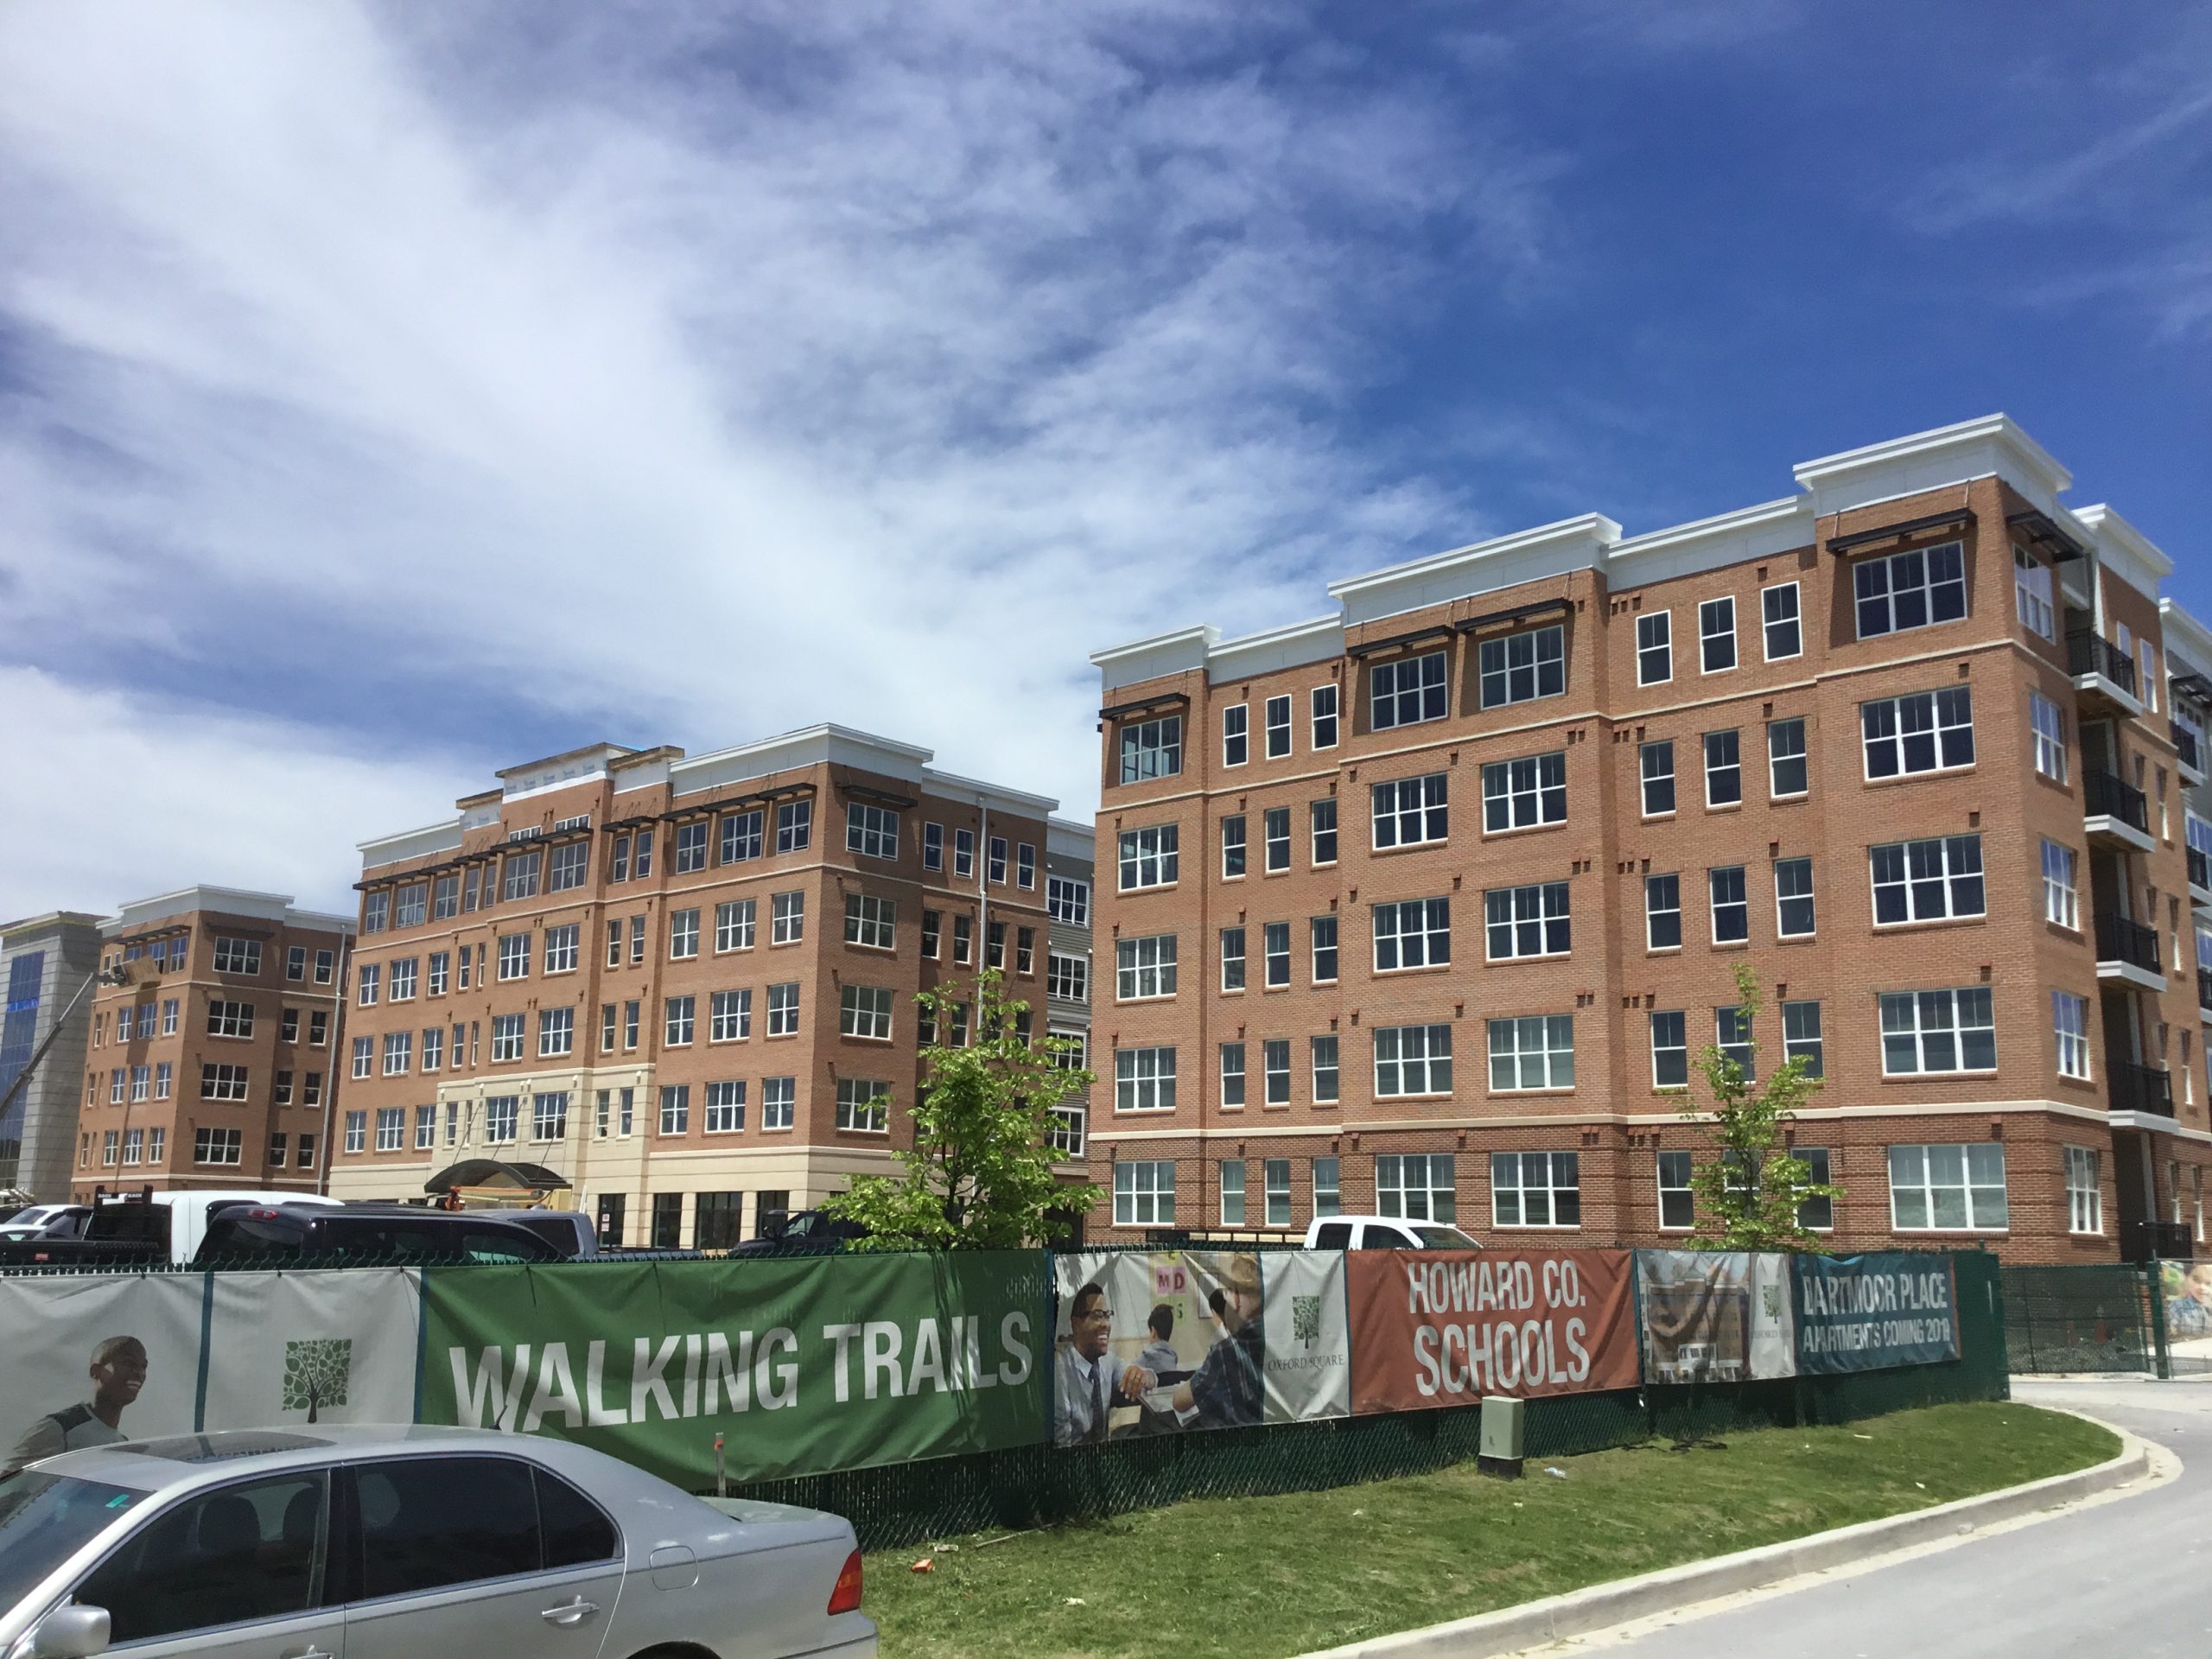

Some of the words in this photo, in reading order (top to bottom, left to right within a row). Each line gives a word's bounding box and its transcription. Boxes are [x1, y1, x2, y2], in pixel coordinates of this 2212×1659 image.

[1174, 1272, 1185, 1290] D
[1408, 1261, 1534, 1314] HOWARD
[1542, 1259, 1586, 1309] CO.
[1802, 1274, 1897, 1315] DARTMOOR
[1899, 1272, 1948, 1310] PLACE
[1414, 1317, 1591, 1397] SCHOOLS
[1802, 1322, 1882, 1353] APARTMENTS
[1883, 1318, 1925, 1348] COMING
[448, 1326, 799, 1433] WALKING
[823, 1310, 1033, 1403] TRAILS
[1268, 1357, 1307, 1372] OXFORD
[1309, 1353, 1344, 1370] SQUARE
